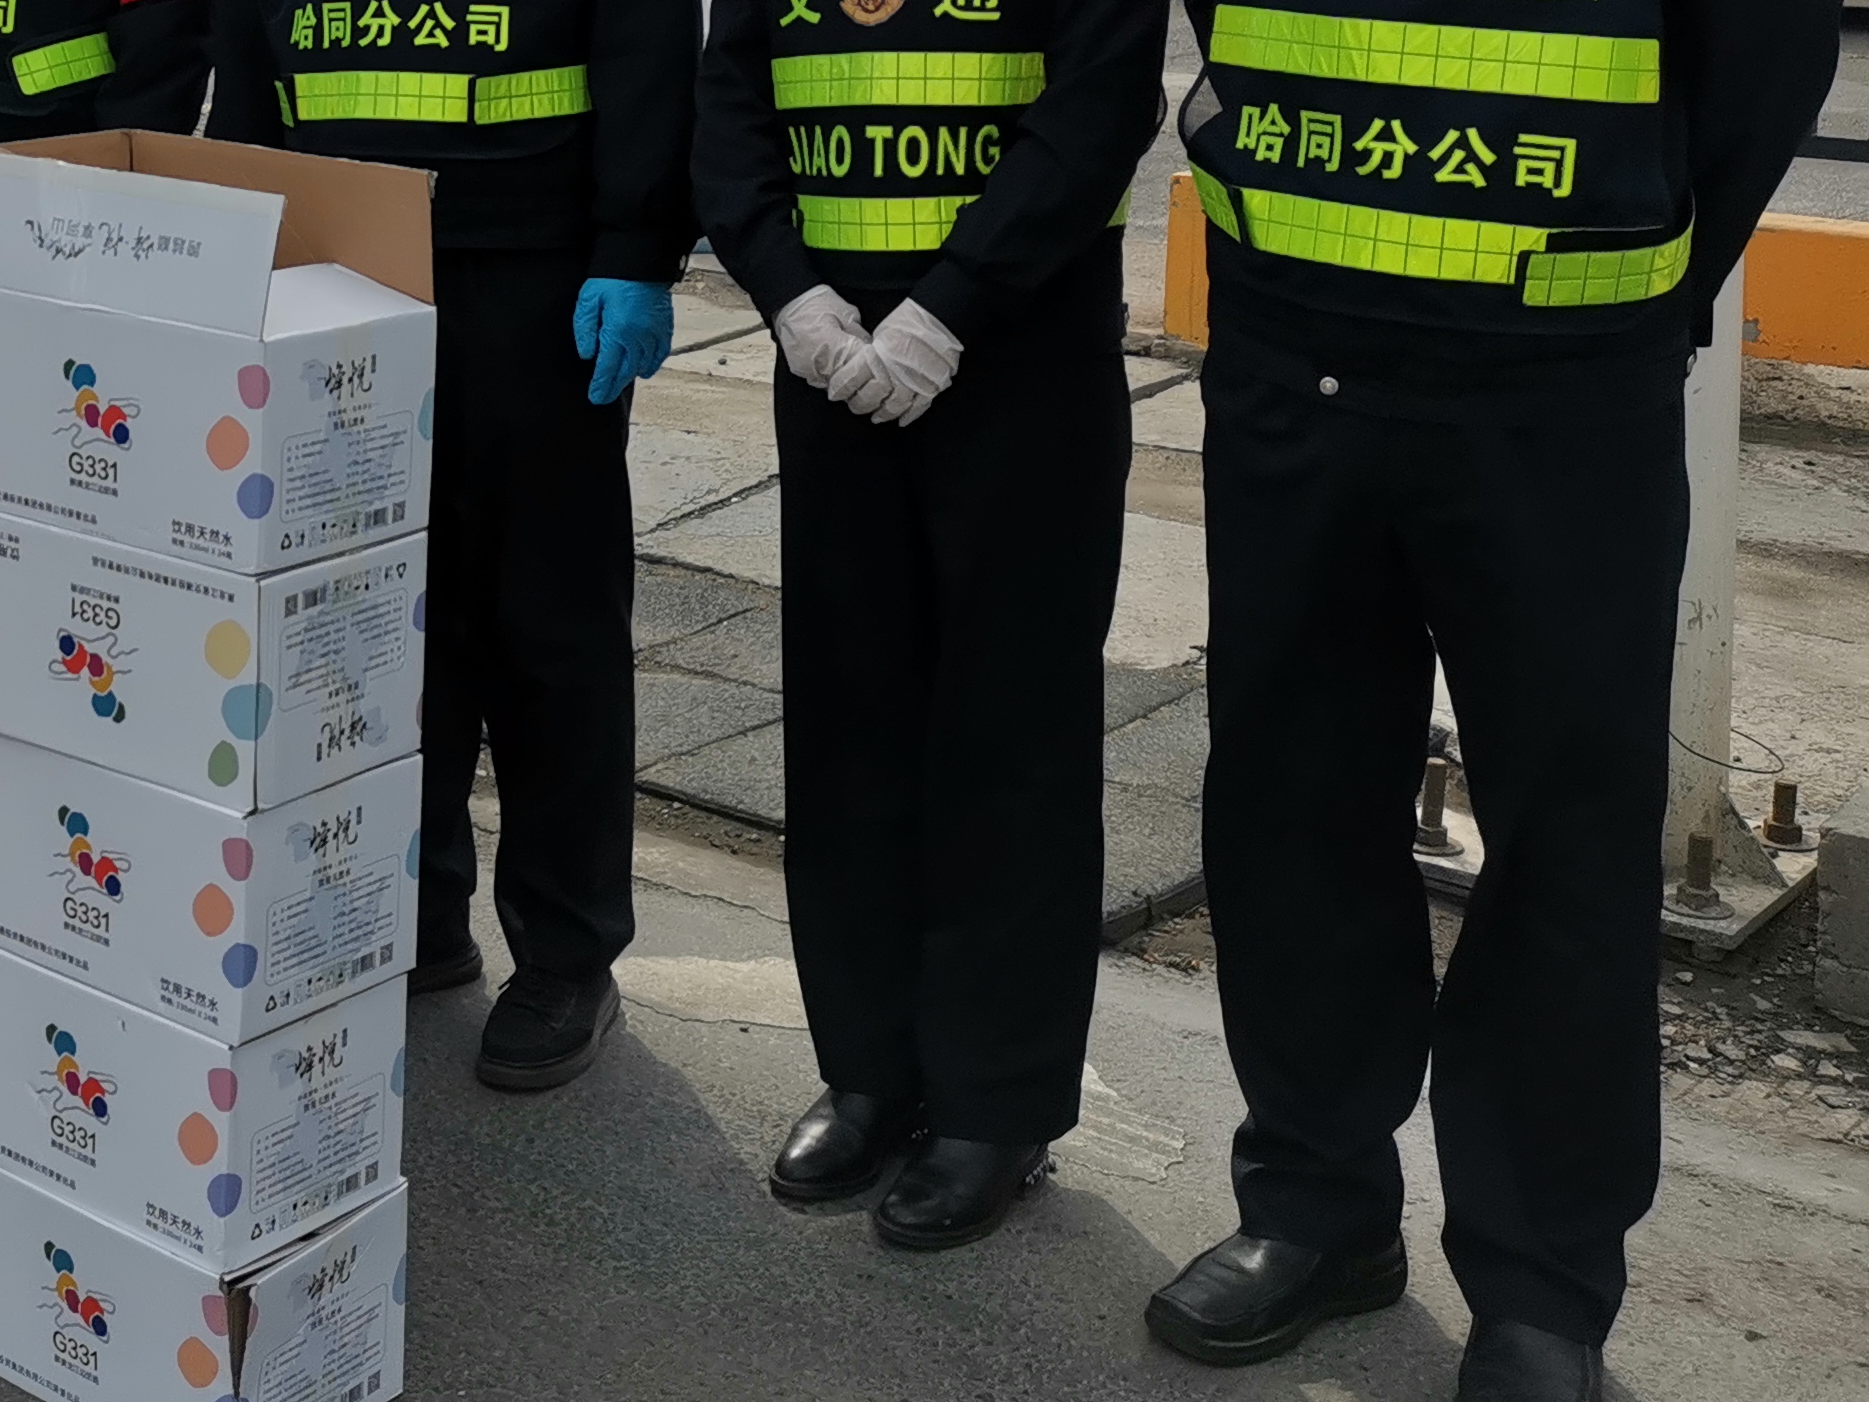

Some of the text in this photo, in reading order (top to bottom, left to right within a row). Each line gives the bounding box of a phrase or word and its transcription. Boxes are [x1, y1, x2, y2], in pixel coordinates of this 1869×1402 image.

[289, 0, 511, 52] 哈同分公司
[788, 124, 1001, 179] JIAO TONG
[1235, 102, 1578, 198] 哈同分公司
[68, 452, 119, 484] G331
[171, 518, 234, 547] 饮用天然水
[70, 597, 121, 630] G331
[62, 896, 111, 934] G331
[159, 976, 220, 1013] 饮用天然水
[50, 1114, 98, 1154] G331
[145, 1200, 205, 1242] 饮用天然水
[52, 1330, 100, 1372] G331
